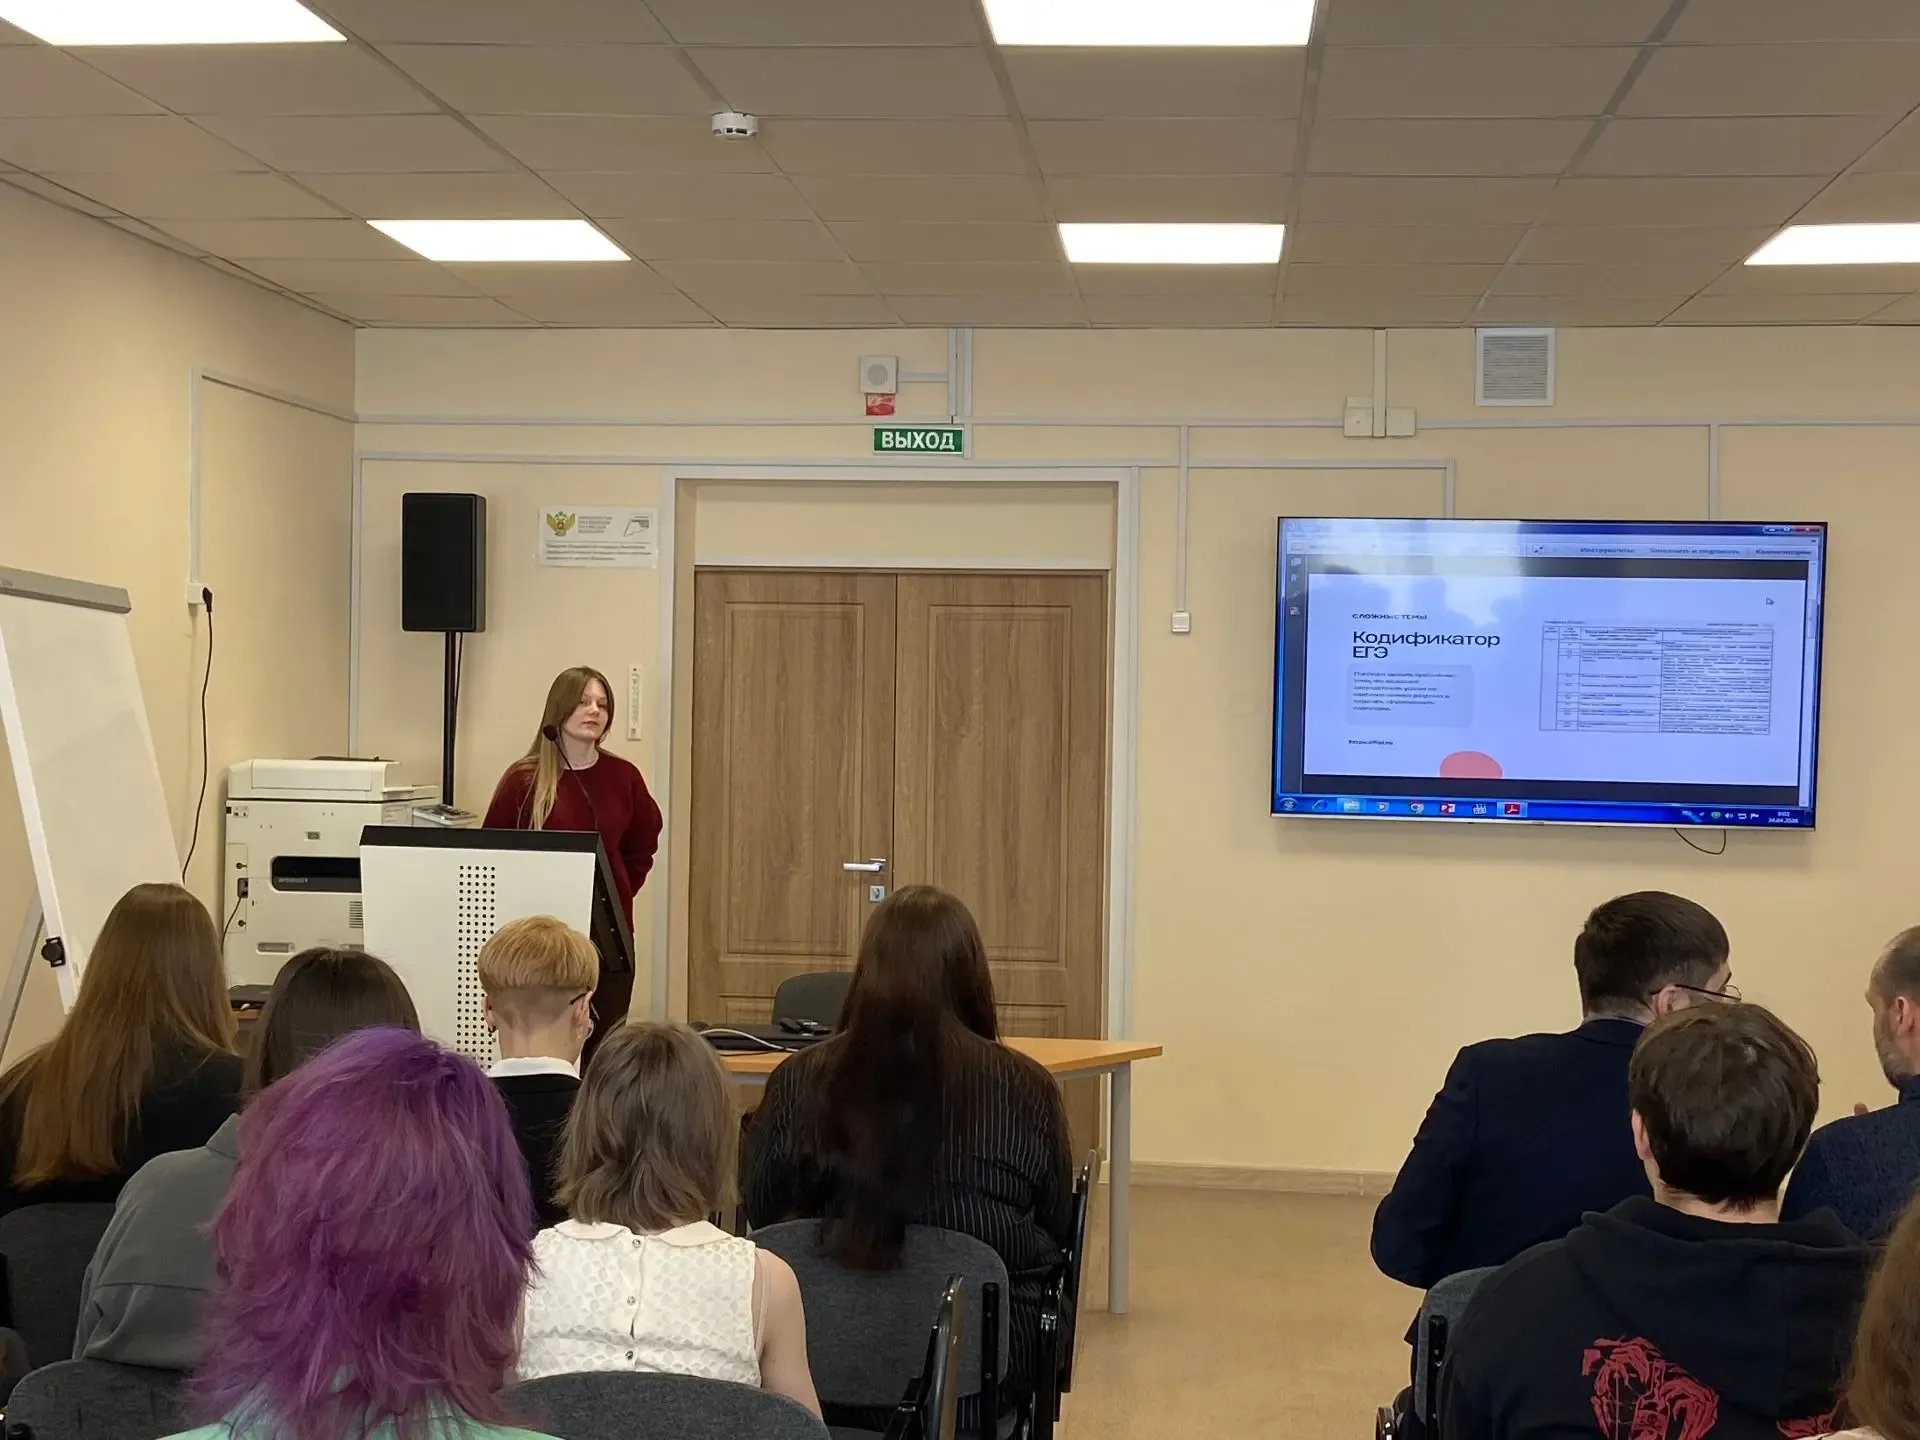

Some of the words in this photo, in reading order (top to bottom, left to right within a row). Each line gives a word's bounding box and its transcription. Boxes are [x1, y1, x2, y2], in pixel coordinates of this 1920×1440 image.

[881, 431, 955, 451] ВЫХОД
[1353, 631, 1500, 648] Кодификатор
[1353, 646, 1388, 659] ЕГЭ
